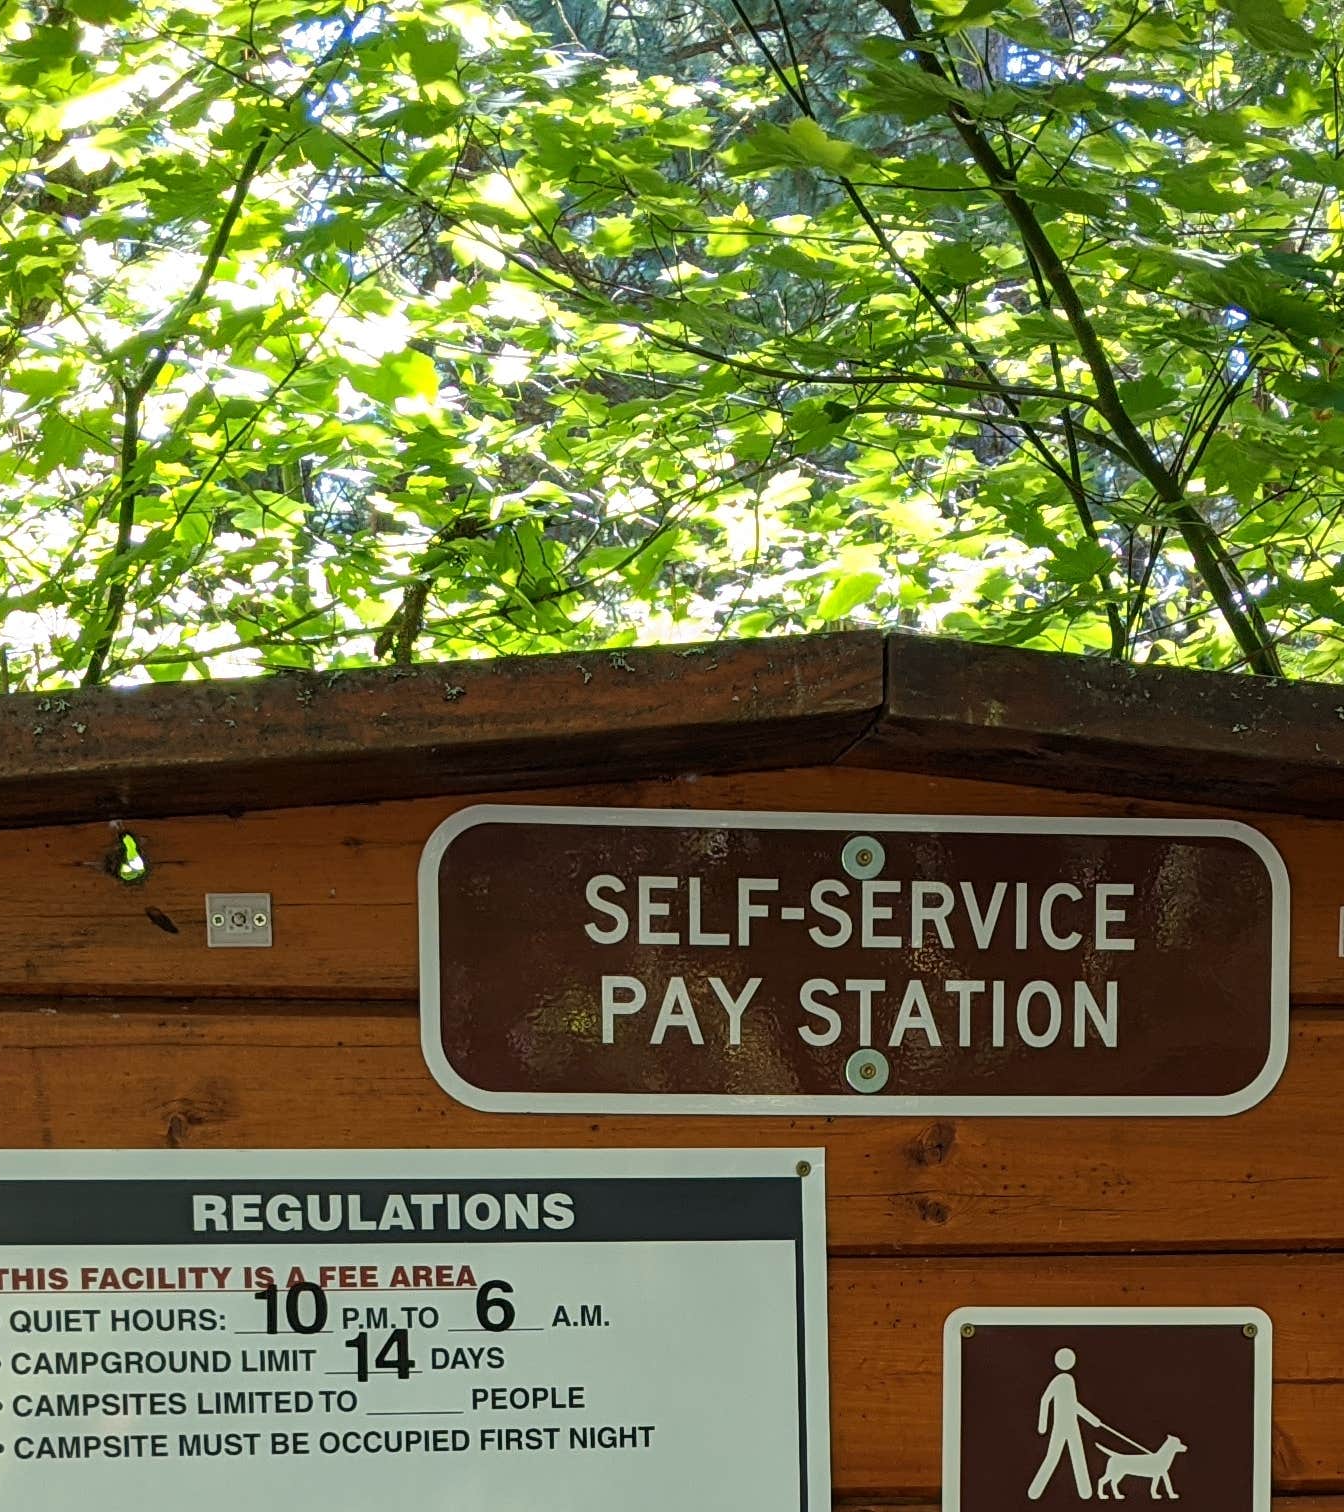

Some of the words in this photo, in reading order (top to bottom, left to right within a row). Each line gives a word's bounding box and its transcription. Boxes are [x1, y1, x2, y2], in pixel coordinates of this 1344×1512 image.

[584, 875, 1135, 952] SELF-SERVICE
[602, 976, 762, 1045] PAY
[798, 979, 1117, 1047] STATION
[193, 1193, 574, 1231] REGULATIONS
[14, 1435, 168, 1459] CAMPSITE
[179, 1434, 260, 1456] MUST
[271, 1433, 309, 1454] BE
[320, 1430, 469, 1453] OCCUPIED
[481, 1428, 560, 1450] FIRST
[570, 1426, 655, 1448] NIGHT
